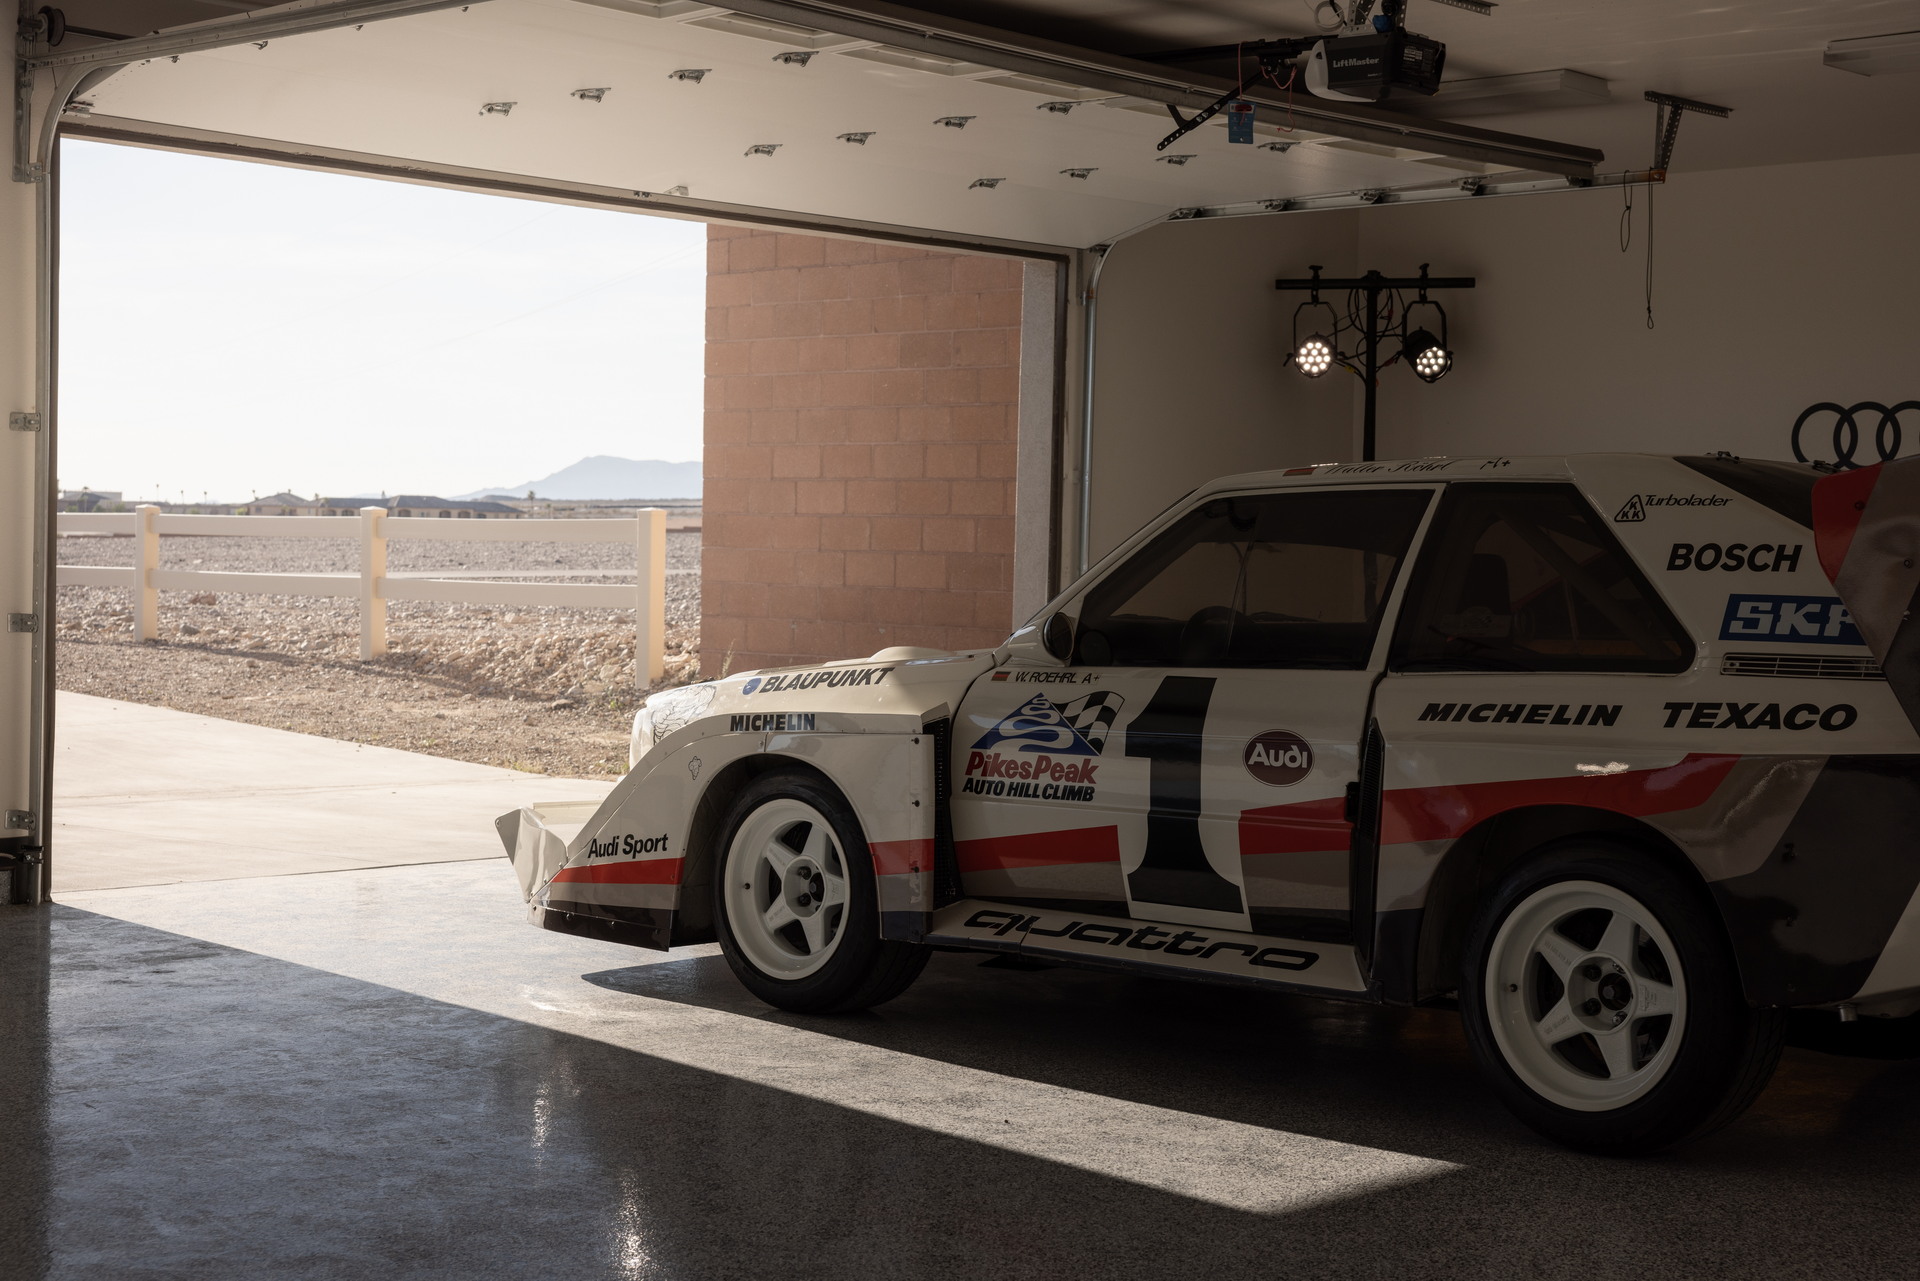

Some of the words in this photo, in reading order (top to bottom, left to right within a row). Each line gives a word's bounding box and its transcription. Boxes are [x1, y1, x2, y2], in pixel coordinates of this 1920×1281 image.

[1332, 57, 1380, 68] LiftMaster
[1644, 494, 1733, 506] Turbolader
[1666, 543, 1803, 572] BOSCH
[759, 667, 896, 693] BLAUPUNKT
[1028, 671, 1077, 684] ROEHRL
[730, 713, 816, 732] MICHELIN
[1417, 703, 1623, 727] MICHELIN
[1663, 702, 1858, 731] TEXACO
[1247, 742, 1308, 769] Audi
[962, 777, 1006, 796] AUTO
[1125, 676, 1244, 914] 1
[587, 836, 619, 859] Audi
[622, 833, 668, 860] Sport
[963, 910, 1320, 971] quattro
